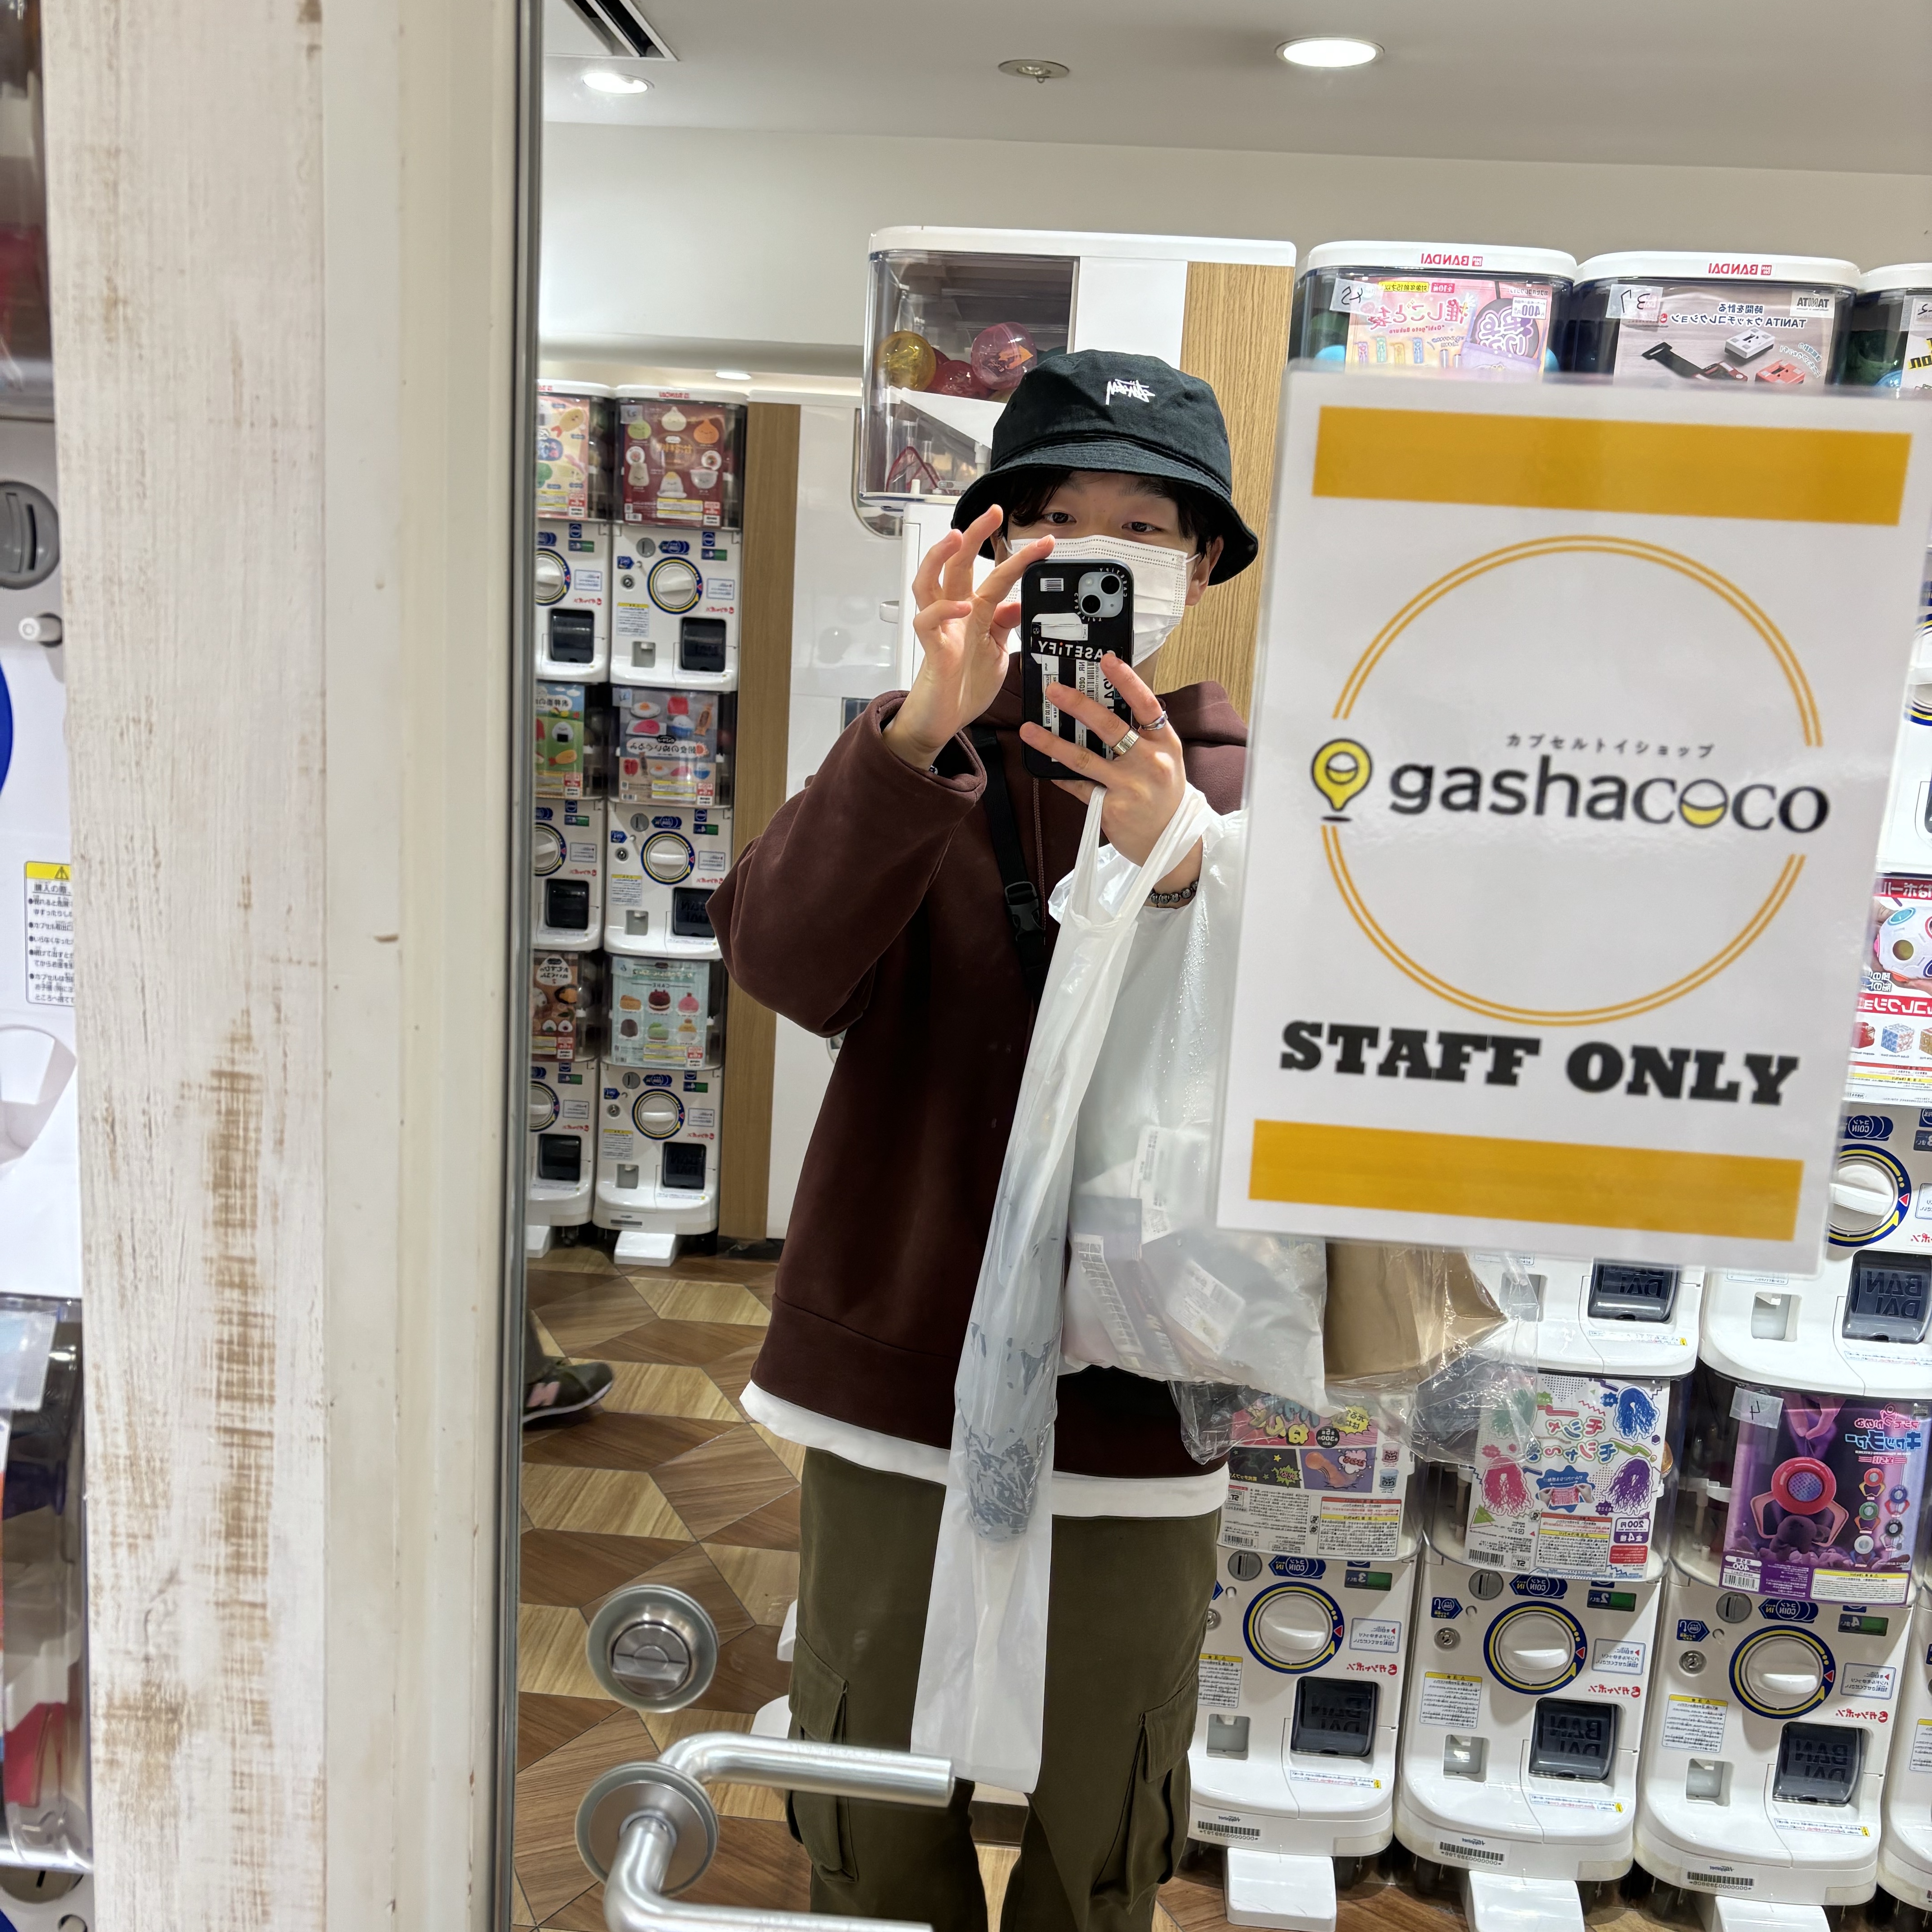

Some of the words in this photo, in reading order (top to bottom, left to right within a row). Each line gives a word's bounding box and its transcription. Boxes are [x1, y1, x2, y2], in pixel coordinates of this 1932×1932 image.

[1389, 754, 1830, 834] gashacoco
[1280, 1020, 1541, 1086] STAFF
[1565, 1041, 1799, 1106] ONLY
